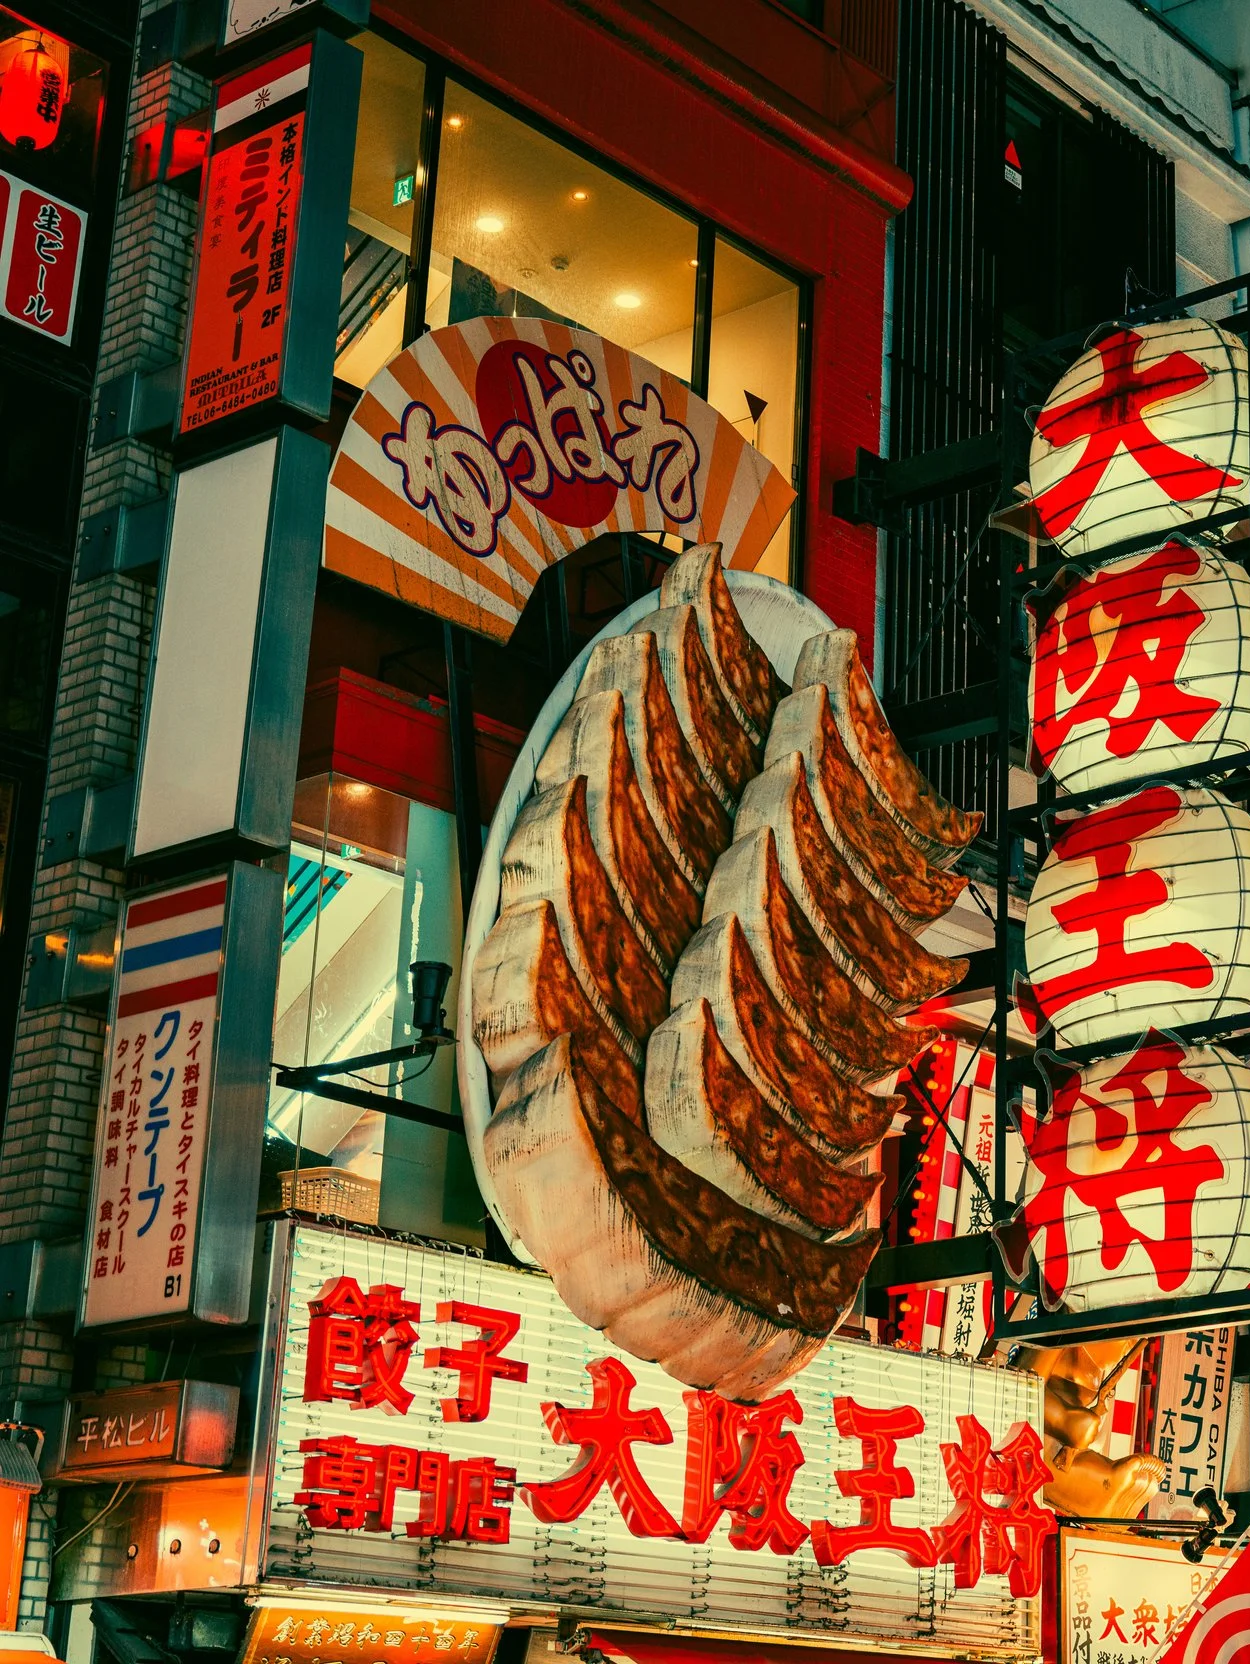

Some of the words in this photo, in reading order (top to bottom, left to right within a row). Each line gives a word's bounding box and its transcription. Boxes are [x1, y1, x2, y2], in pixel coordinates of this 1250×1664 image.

[23, 204, 64, 323] 生ビール
[226, 138, 273, 362] ミティラー
[266, 121, 298, 296] 本格インド料理店
[190, 365, 249, 398] RESTAURANT
[260, 353, 279, 367] BAR
[191, 366, 223, 388] INDIAN
[261, 304, 282, 330] 2F
[991, 321, 1243, 1308] 大阪王将
[104, 1038, 130, 1169] タイ調味料
[112, 1033, 146, 1275] タイカルチャースクール
[136, 1010, 181, 1238] クンテープ
[167, 1020, 203, 1269] タイ料理とタイスキの店
[93, 1200, 114, 1279] 食材店
[164, 1275, 182, 1299] B1
[302, 1276, 529, 1423] 餃子
[76, 1407, 170, 1453] 平松ビル
[517, 1355, 1060, 1599] 大阪王将
[271, 1615, 480, 1661] 創業昭和四十四年
